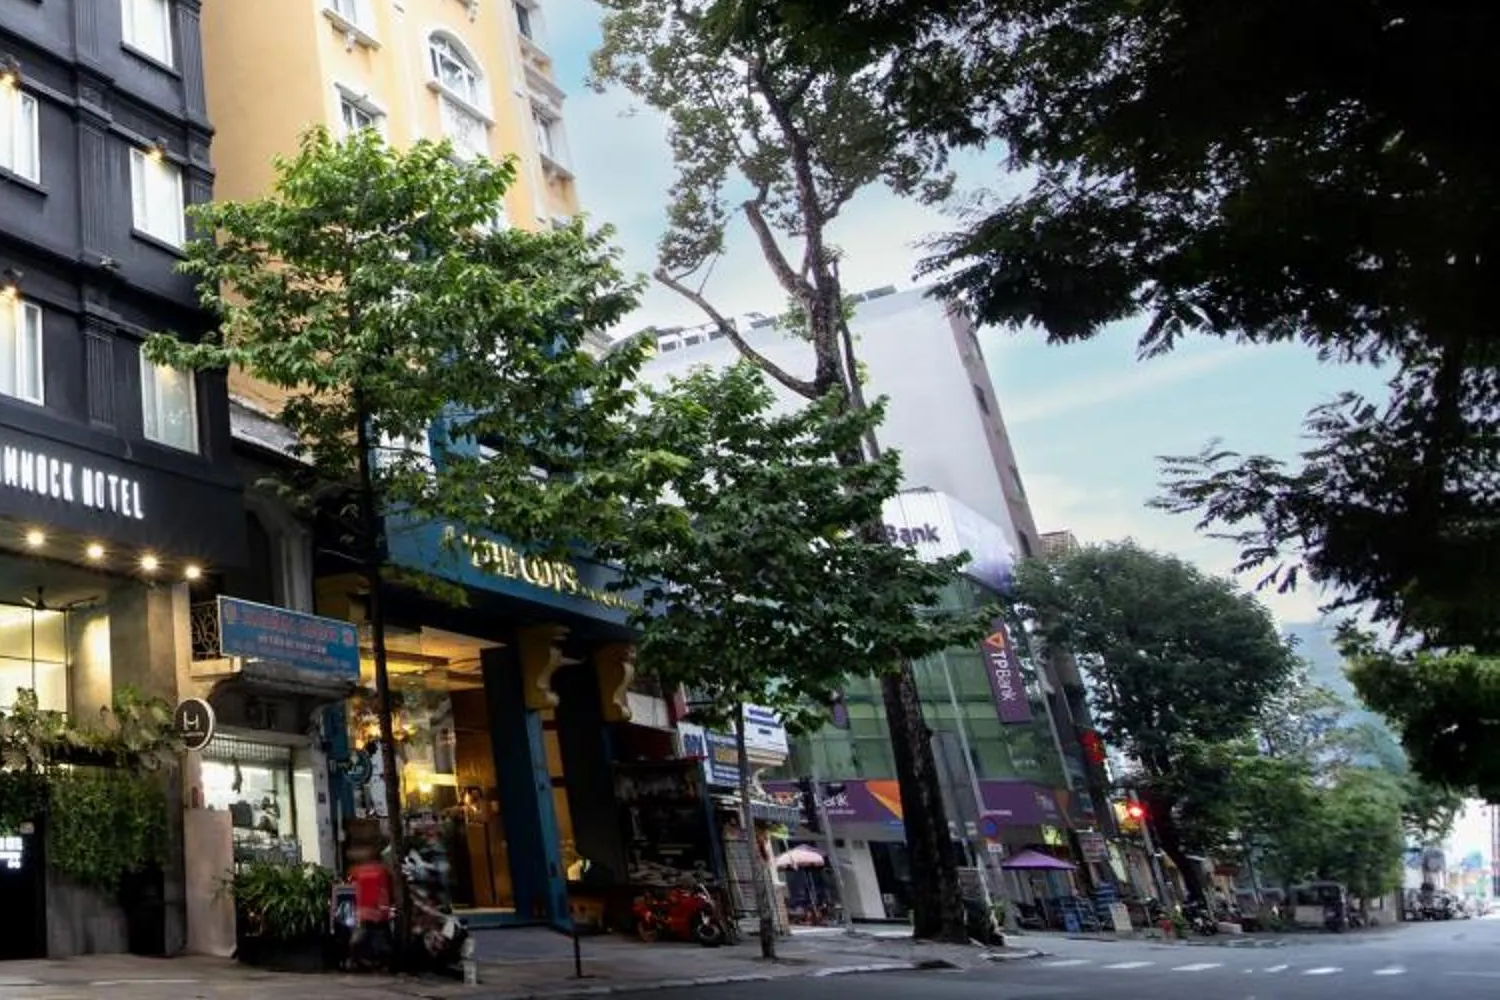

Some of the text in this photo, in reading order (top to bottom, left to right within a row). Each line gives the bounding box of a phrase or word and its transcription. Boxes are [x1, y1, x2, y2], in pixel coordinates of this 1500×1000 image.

[81, 466, 144, 520] HOTEL
[885, 523, 940, 545] Bank
[990, 652, 1017, 702] TPBank
